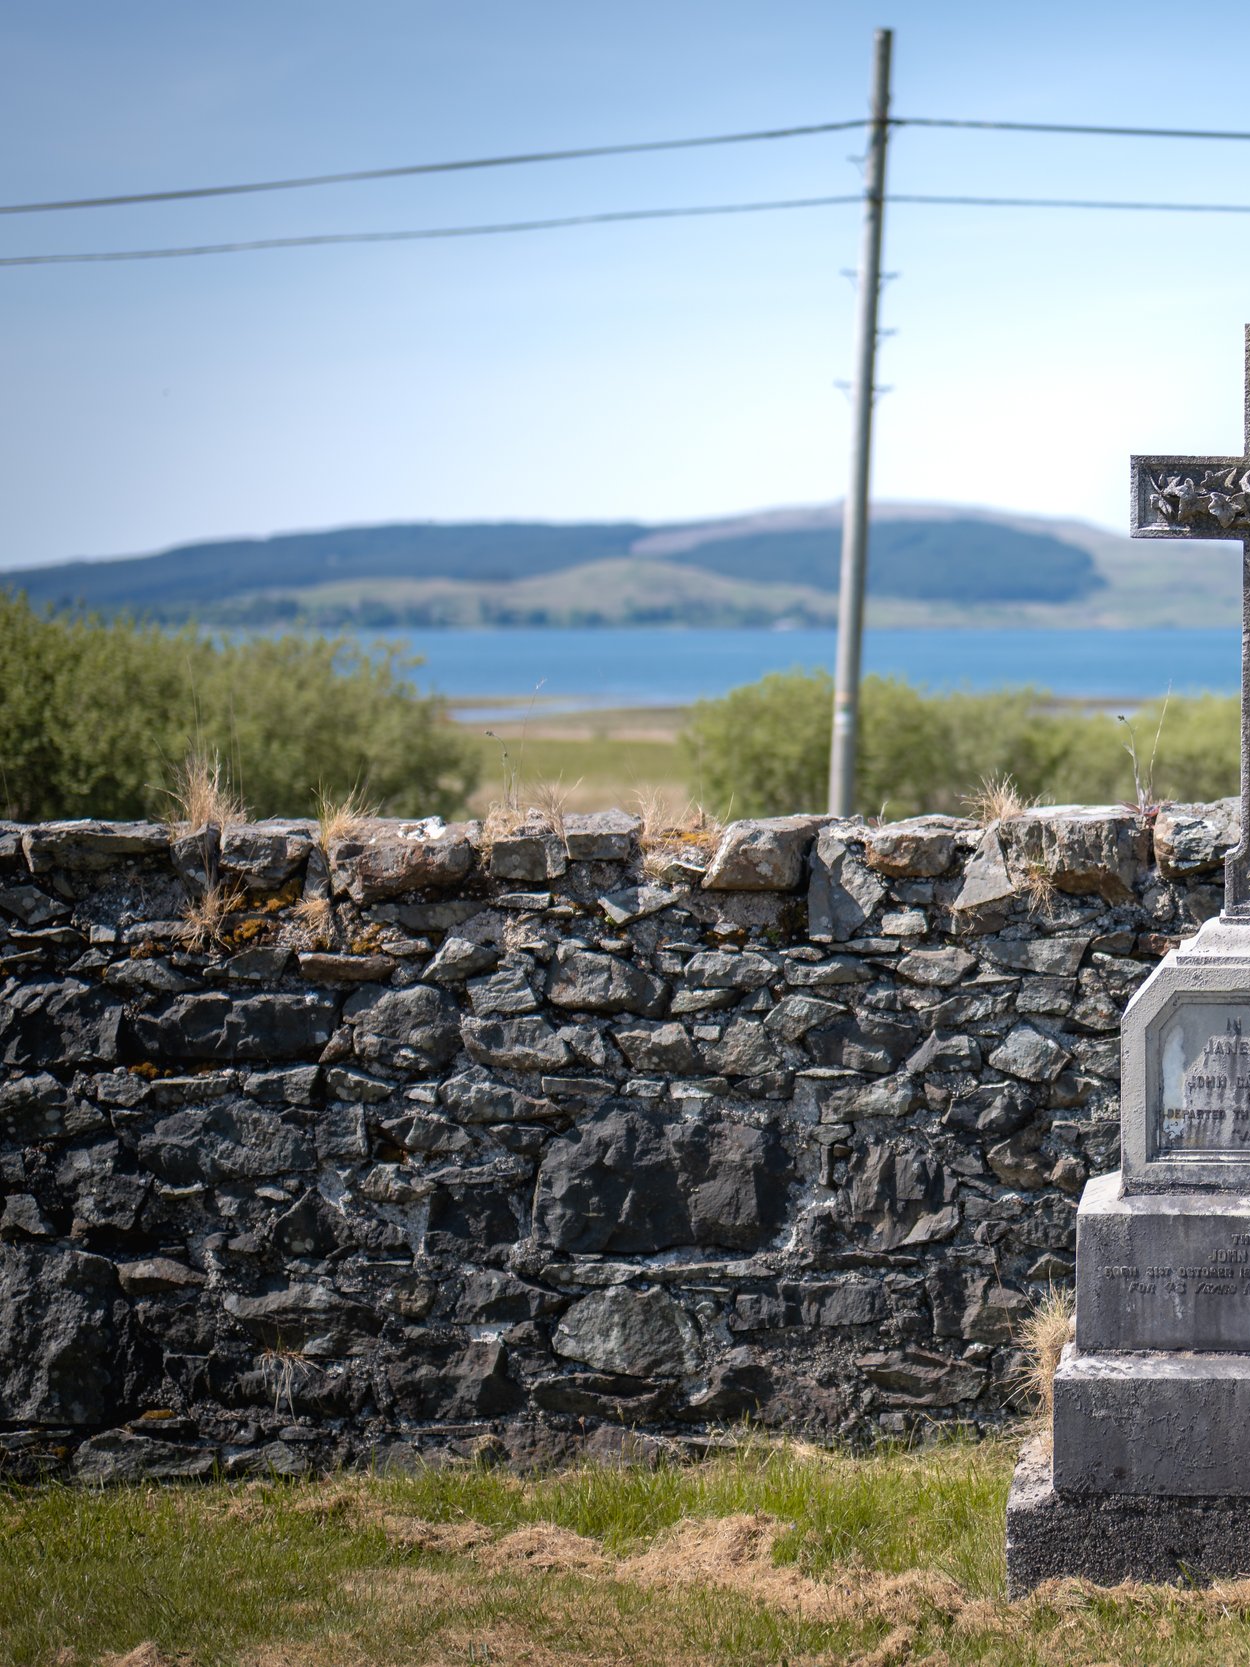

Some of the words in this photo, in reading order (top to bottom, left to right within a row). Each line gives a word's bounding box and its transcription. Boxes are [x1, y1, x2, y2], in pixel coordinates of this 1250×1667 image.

[1226, 1018, 1242, 1035] IN
[1204, 1039, 1249, 1056] JANE
[1187, 1075, 1227, 1090] JOHN
[1167, 1109, 1226, 1120] DEPARTED
[1208, 1248, 1249, 1263] JOHN
[1103, 1266, 1138, 1280] BORN
[1178, 1266, 1235, 1280] OCTOBER
[1128, 1281, 1157, 1294] FOR
[1194, 1281, 1238, 1295] YEARS
